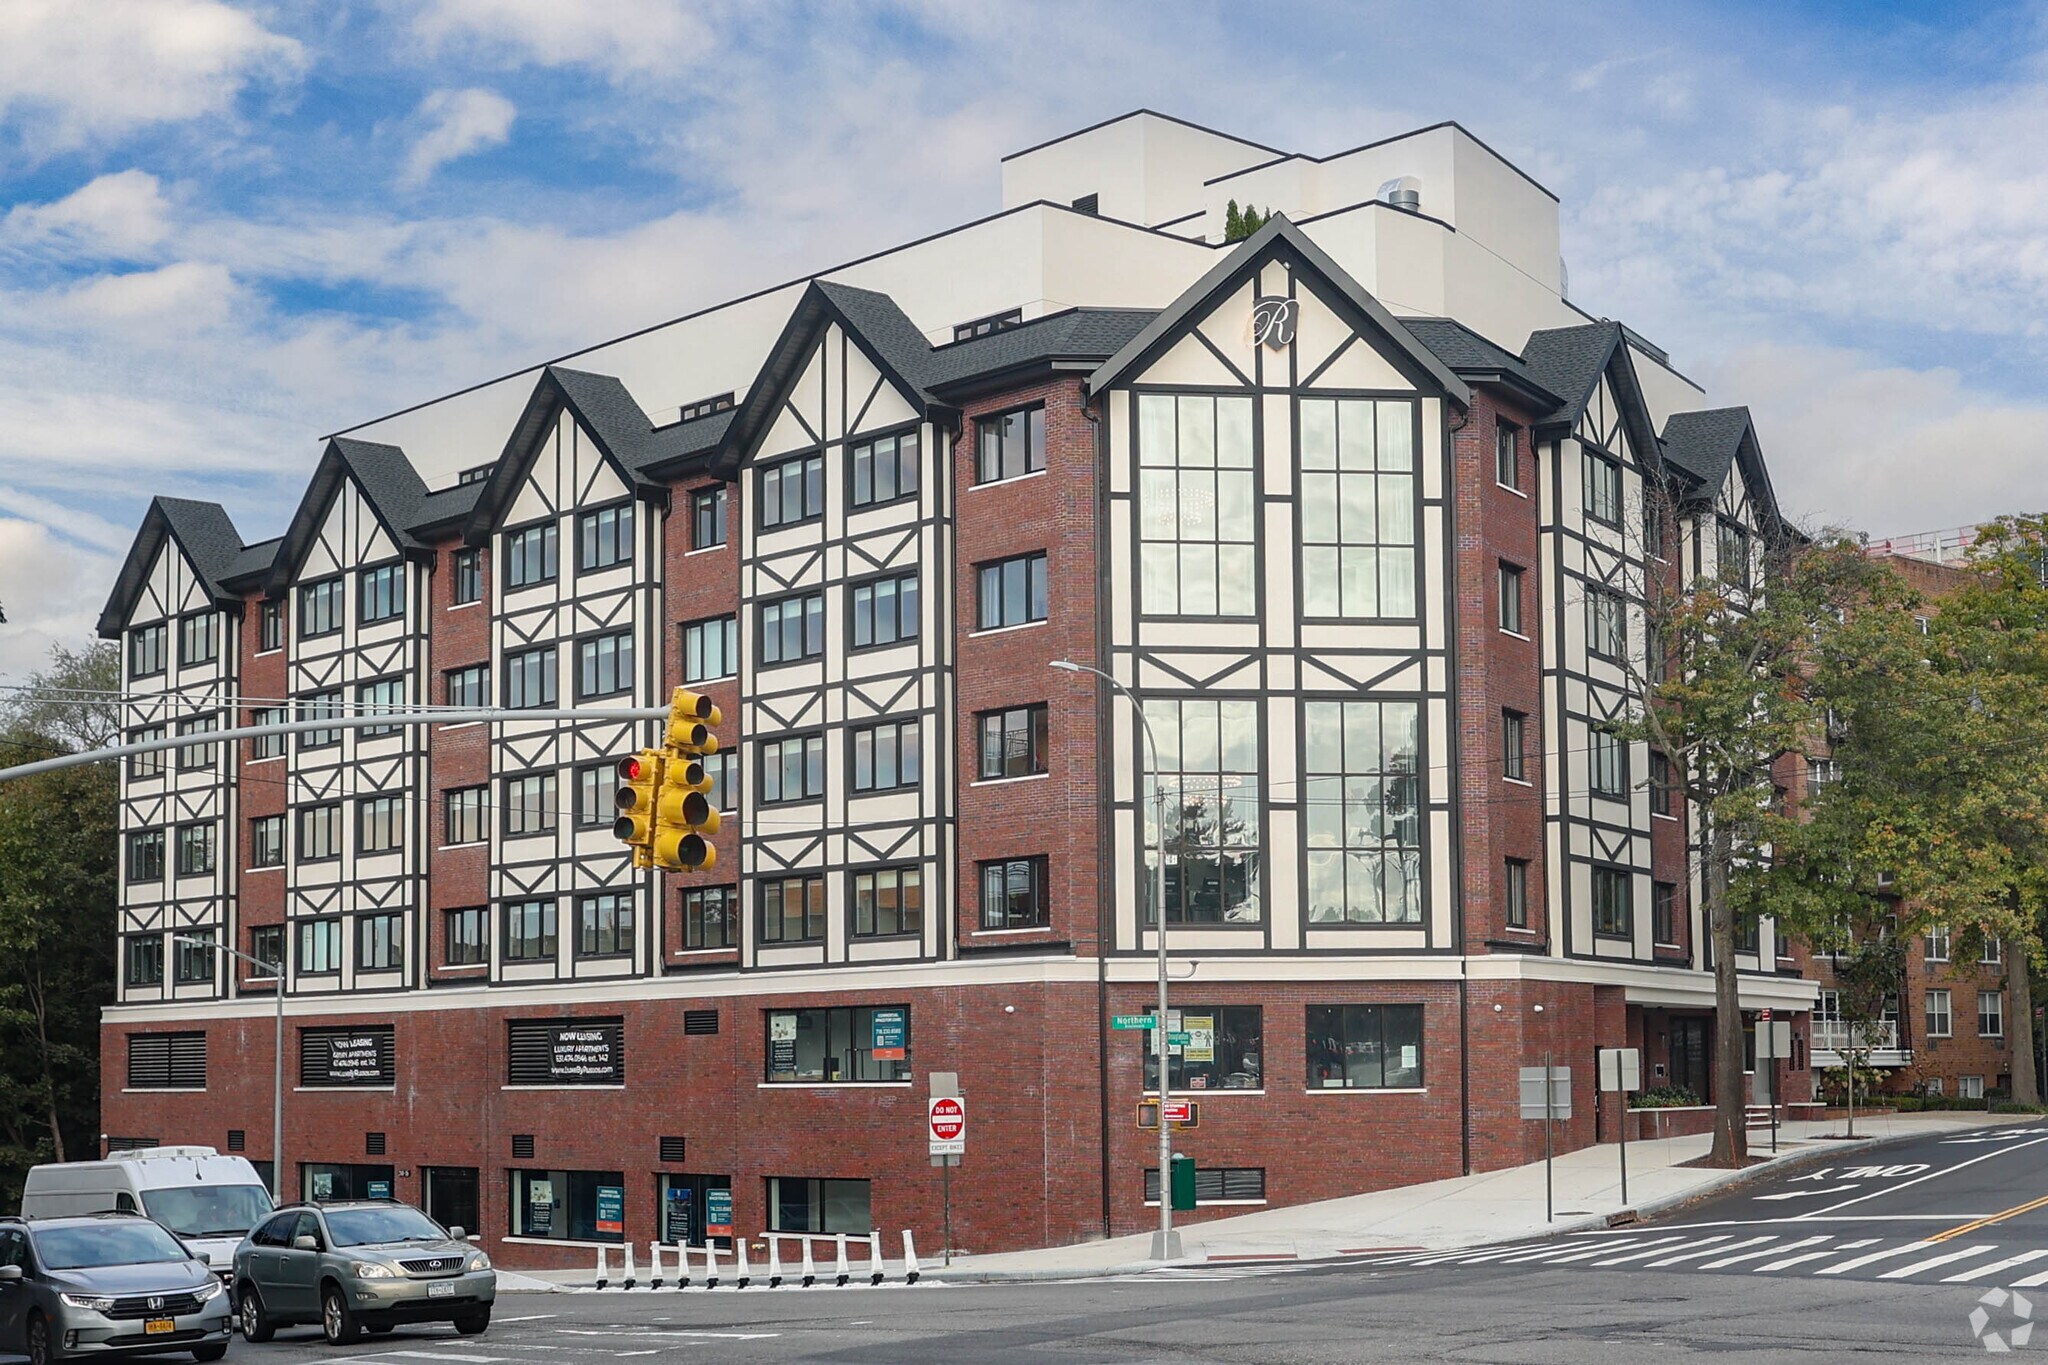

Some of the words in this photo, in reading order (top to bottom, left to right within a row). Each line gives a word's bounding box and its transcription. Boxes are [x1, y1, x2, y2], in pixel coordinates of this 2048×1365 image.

[1117, 1017, 1152, 1025] Northern
[559, 1032, 576, 1041] NOW
[576, 1031, 603, 1041] LEASING
[349, 1038, 373, 1048] LEASING
[554, 1045, 575, 1053] LUXURY
[575, 1044, 610, 1053] APARTMENTS
[598, 1054, 609, 1062] 142
[935, 1106, 945, 1114] DO
[945, 1106, 958, 1114] NOT
[937, 1124, 957, 1132] ENTER
[1787, 1164, 1931, 1182] ONLY
